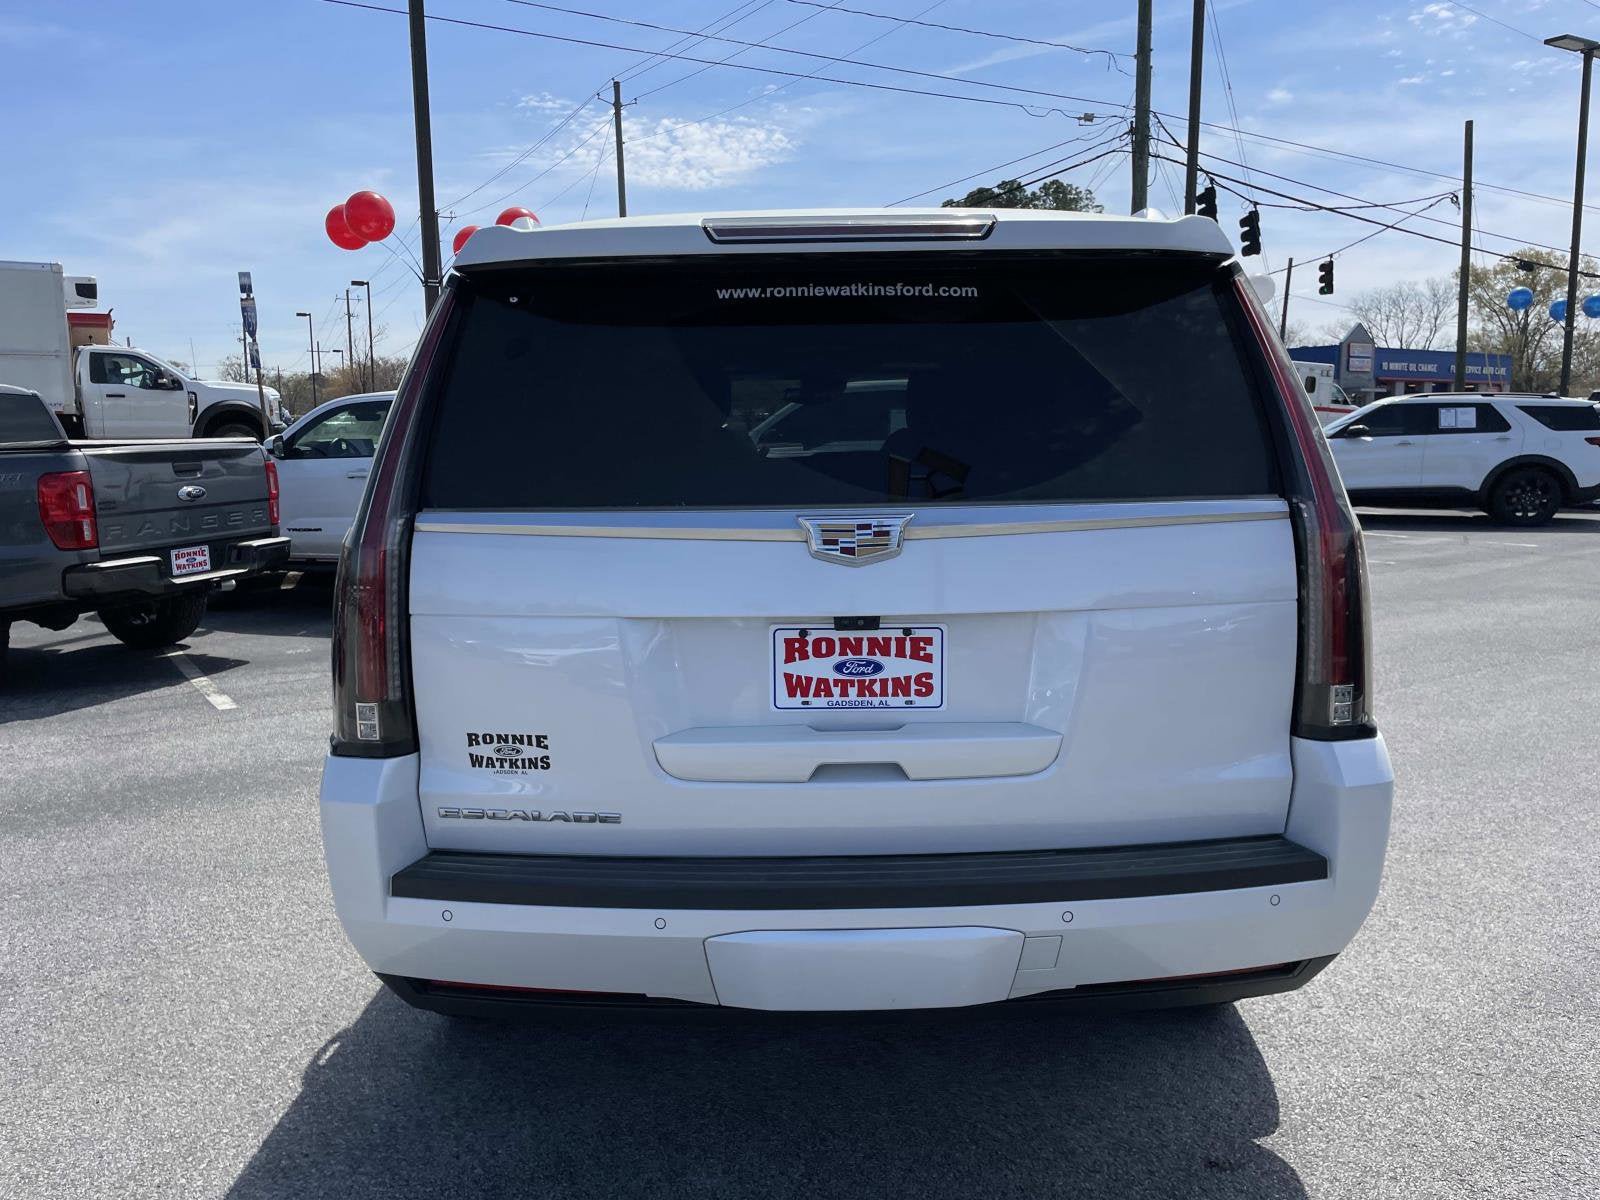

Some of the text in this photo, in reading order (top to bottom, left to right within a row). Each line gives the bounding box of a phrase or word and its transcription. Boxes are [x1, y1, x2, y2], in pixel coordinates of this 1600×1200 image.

[716, 283, 978, 299] www.ronniewatkinsford.com
[1389, 362, 1408, 371] MINUTE
[1418, 363, 1438, 373] CHANGE
[106, 510, 267, 540] RANGER
[175, 548, 207, 561] RONNIE
[175, 559, 208, 571] WATKINS
[783, 637, 934, 664] RONNIE
[843, 660, 874, 674] Ford
[783, 671, 935, 698] WATKINS
[827, 700, 876, 708] GADSDEN,
[466, 732, 549, 750] RONNIE
[468, 753, 551, 771] WATKINS
[437, 807, 622, 824] ESCALADE
